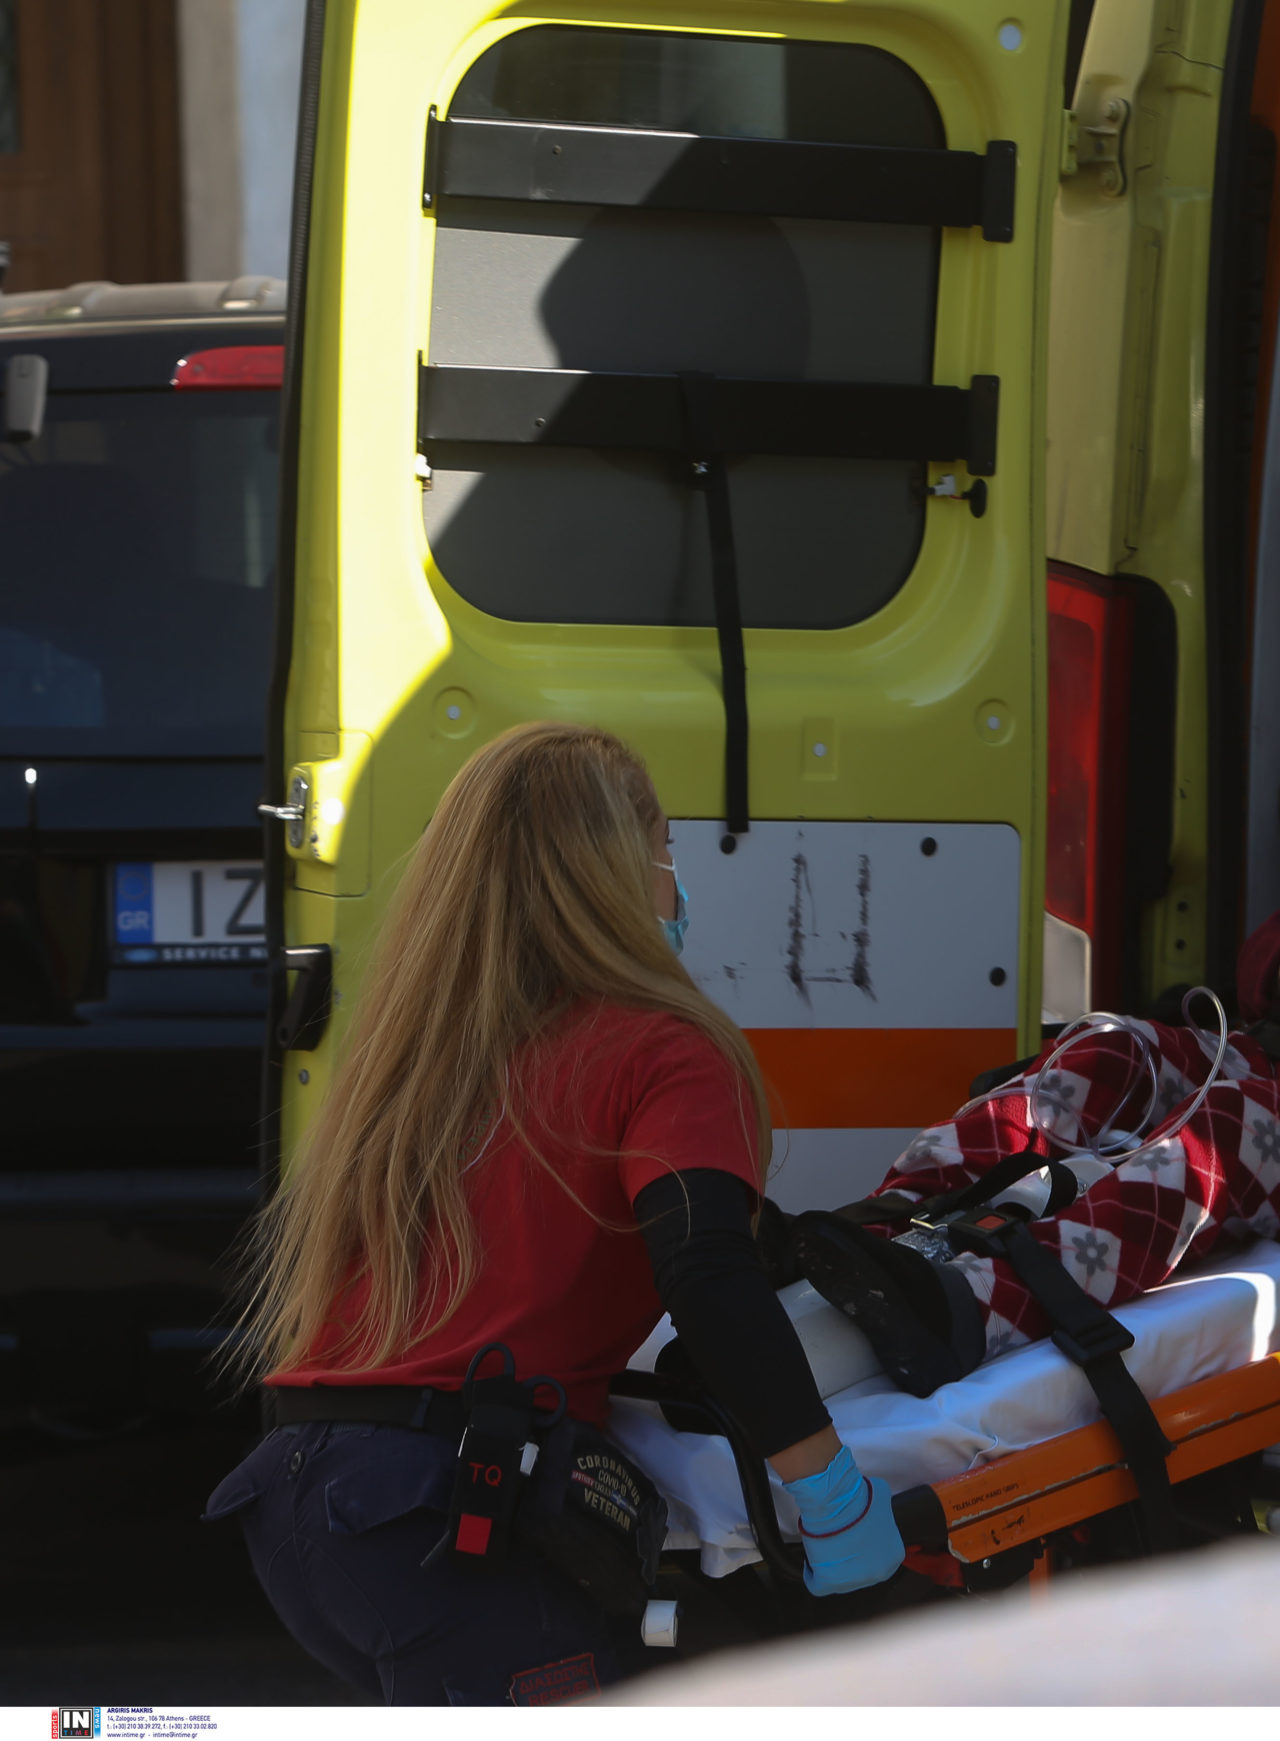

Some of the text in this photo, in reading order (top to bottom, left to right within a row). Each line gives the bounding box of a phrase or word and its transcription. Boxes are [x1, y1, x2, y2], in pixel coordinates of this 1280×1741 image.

[117, 910, 149, 931] GR
[162, 947, 239, 961] SERVICE
[469, 1462, 503, 1487] TQ
[577, 1455, 640, 1506] CORONAVIRUS
[584, 1487, 631, 1531] VETERAN
